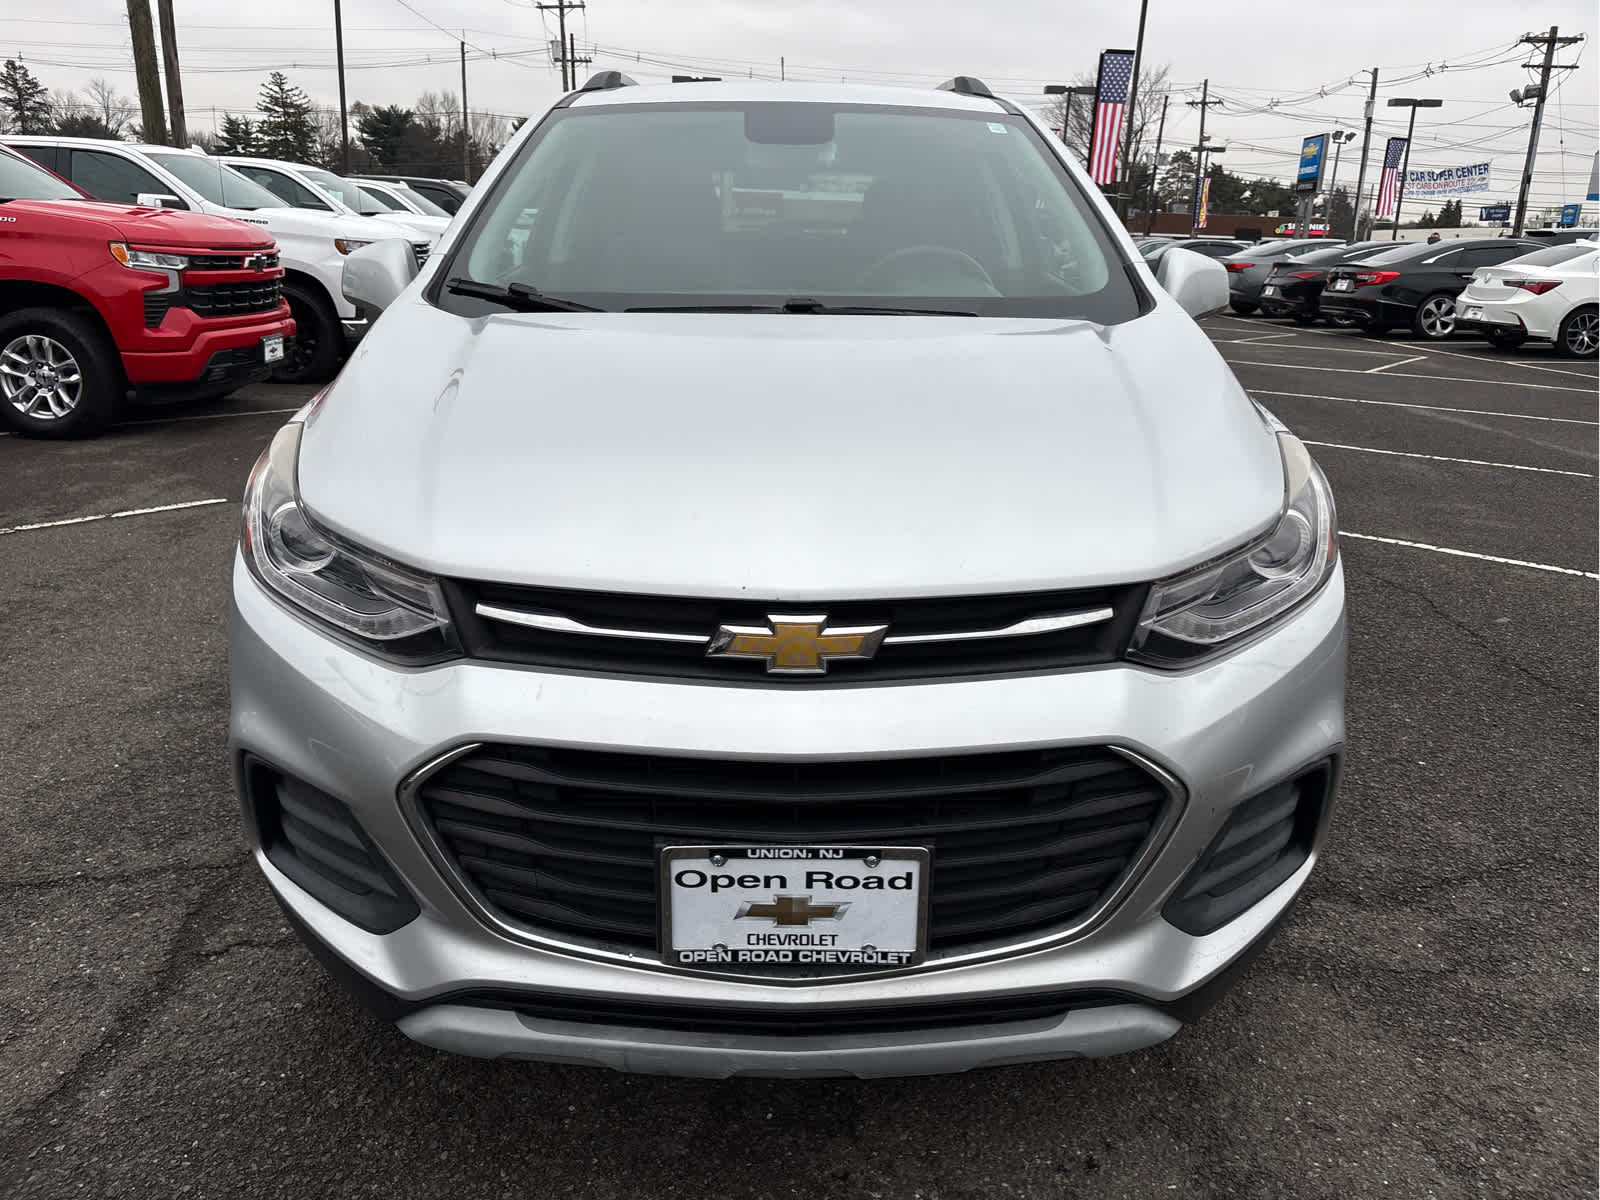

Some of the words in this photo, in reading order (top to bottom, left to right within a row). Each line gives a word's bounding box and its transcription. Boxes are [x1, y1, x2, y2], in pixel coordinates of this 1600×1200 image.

[1409, 171, 1426, 183] CAR
[1456, 163, 1489, 179] CENTER
[1401, 182, 1416, 191] EST
[1432, 181, 1443, 190] ON
[1443, 178, 1465, 189] ROUTE
[819, 849, 844, 859] NJ
[674, 869, 787, 893] Open
[805, 871, 913, 891] Road
[746, 933, 839, 947] CHEVROLET
[679, 950, 732, 963] OPEN
[738, 950, 793, 963] ROAD
[799, 950, 911, 964] CHEVROLET
